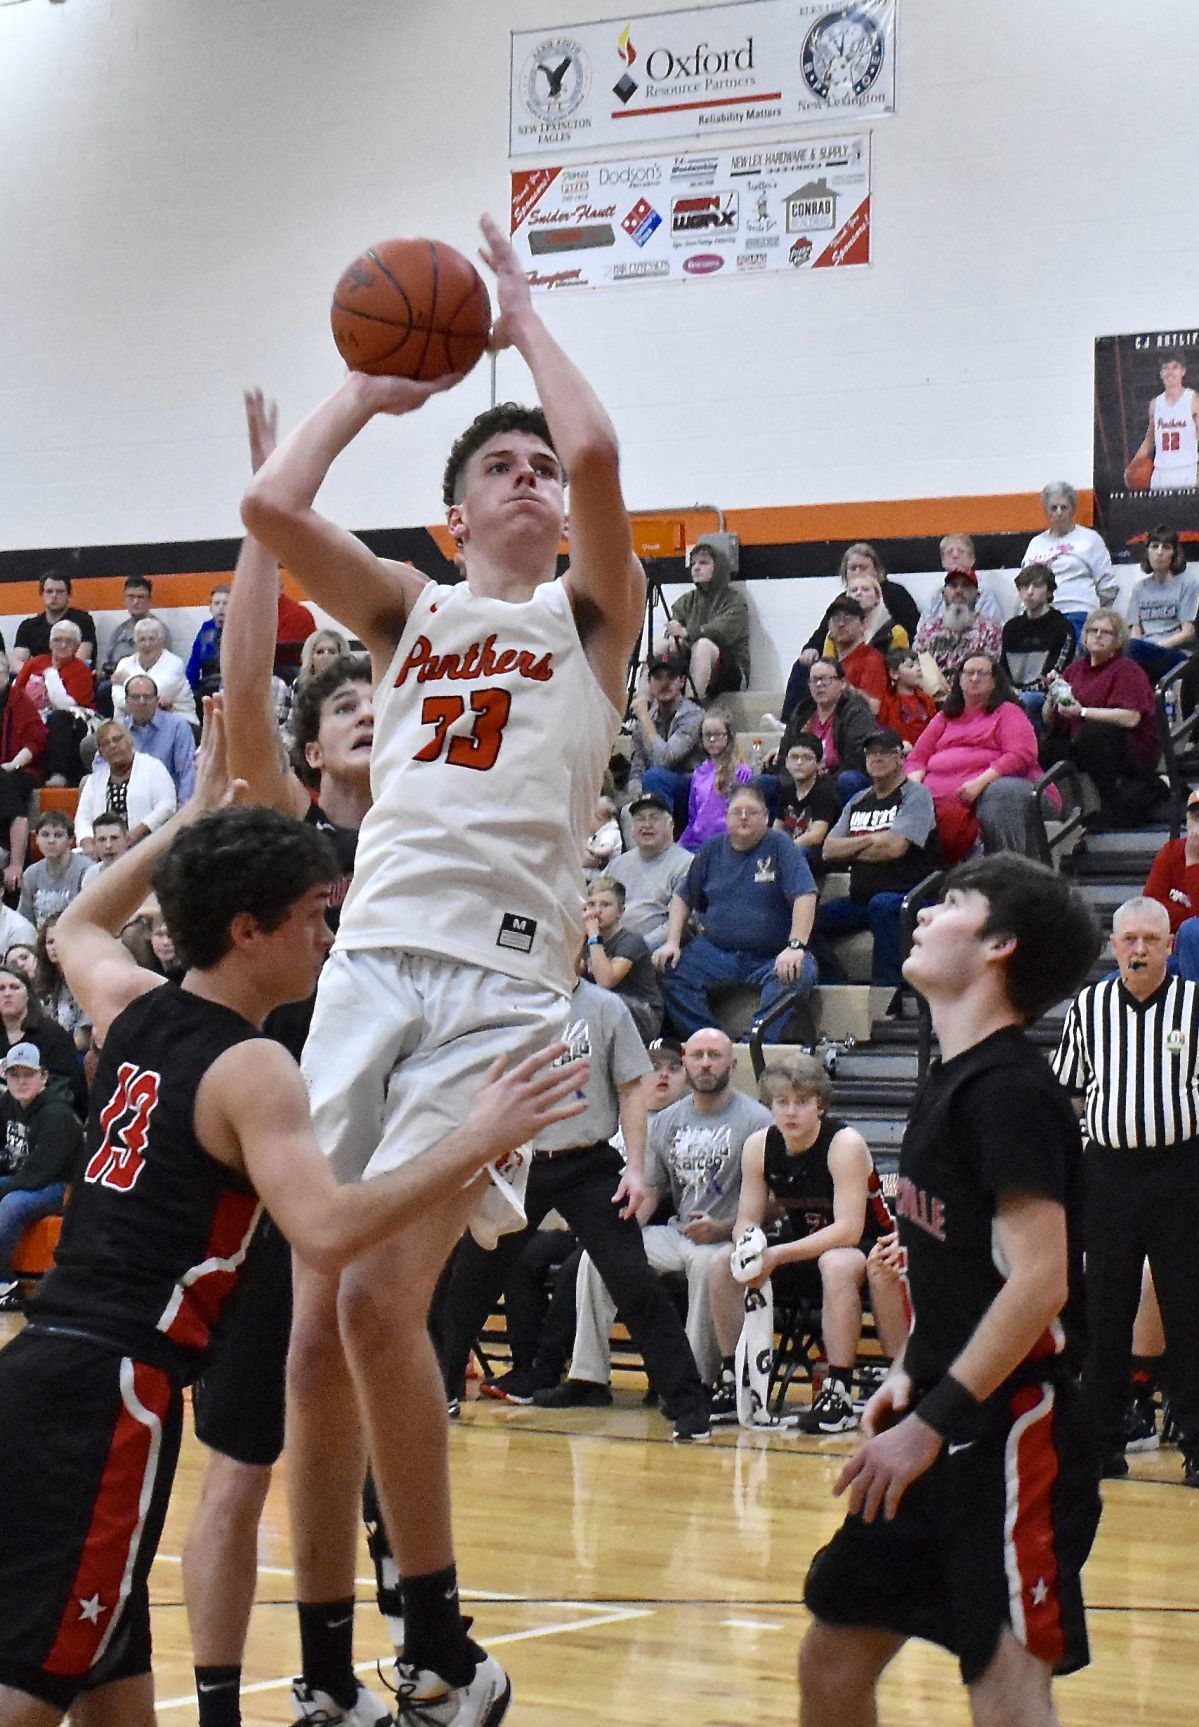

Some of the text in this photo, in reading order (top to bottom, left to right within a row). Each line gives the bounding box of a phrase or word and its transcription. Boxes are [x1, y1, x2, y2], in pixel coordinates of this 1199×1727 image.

[645, 37, 754, 81] Oxford
[646, 76, 756, 98] Resource Partners
[698, 107, 782, 125] Reliability Matters
[599, 163, 662, 186] Dodson's
[791, 200, 831, 218] CONRAD
[393, 634, 554, 688] Panthers
[84, 1061, 162, 1192] 13
